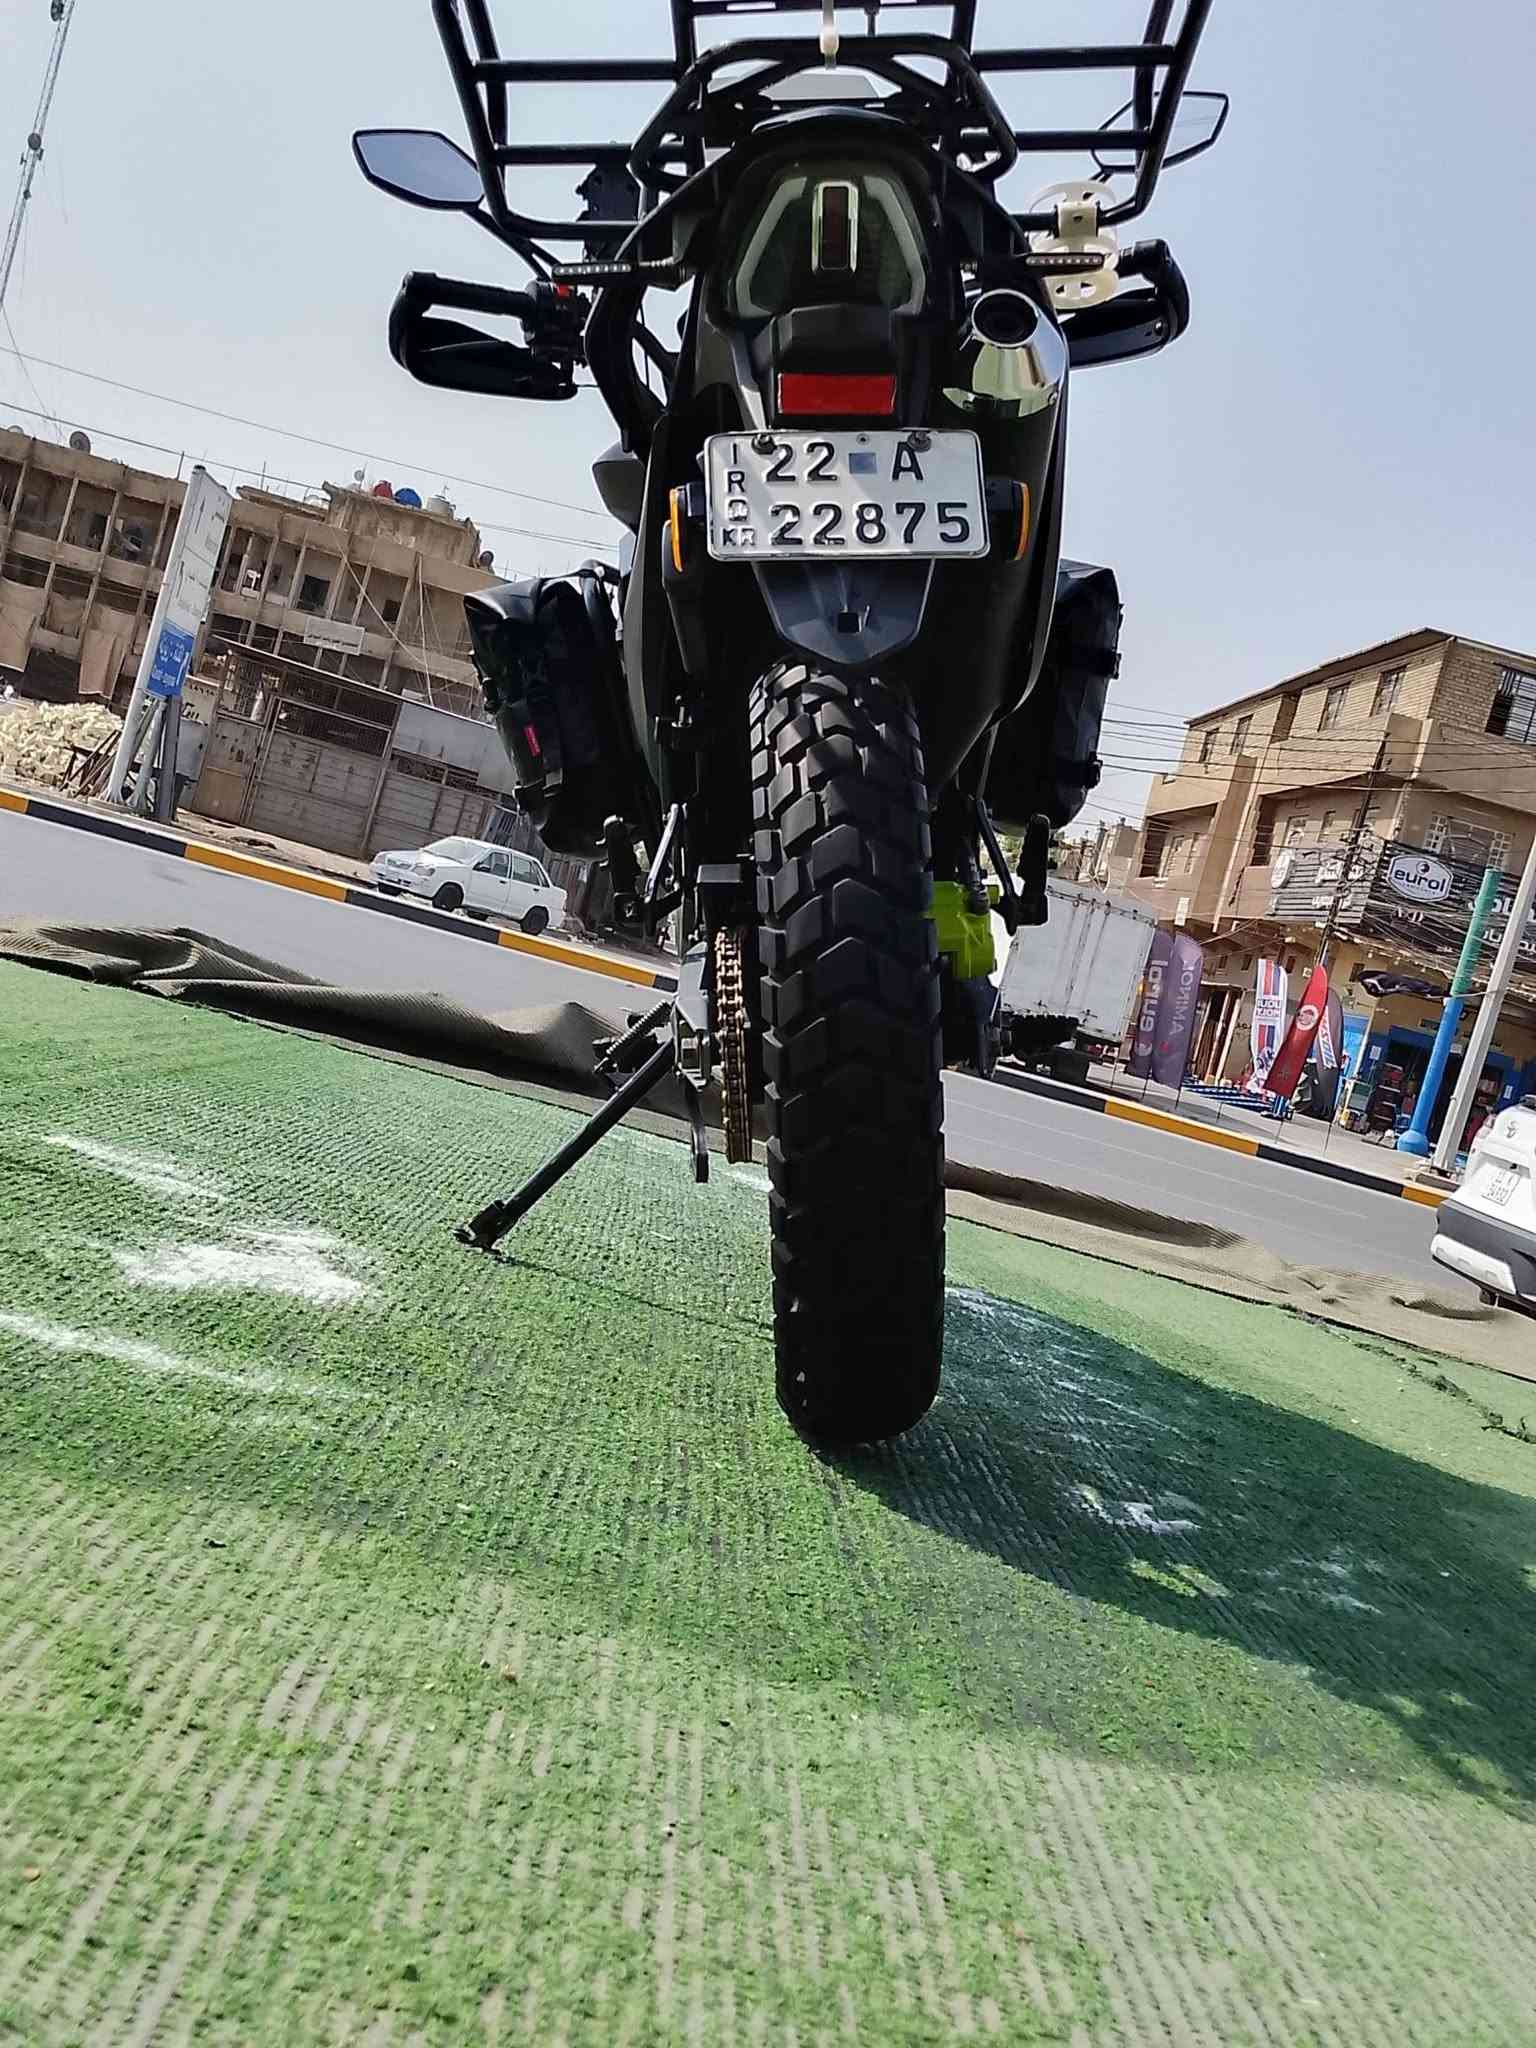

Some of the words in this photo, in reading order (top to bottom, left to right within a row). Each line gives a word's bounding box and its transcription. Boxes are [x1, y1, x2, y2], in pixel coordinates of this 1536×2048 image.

[766, 441, 839, 482] 22
[891, 441, 924, 481] A
[769, 501, 971, 546] 22875
[1393, 868, 1447, 893] eurol
